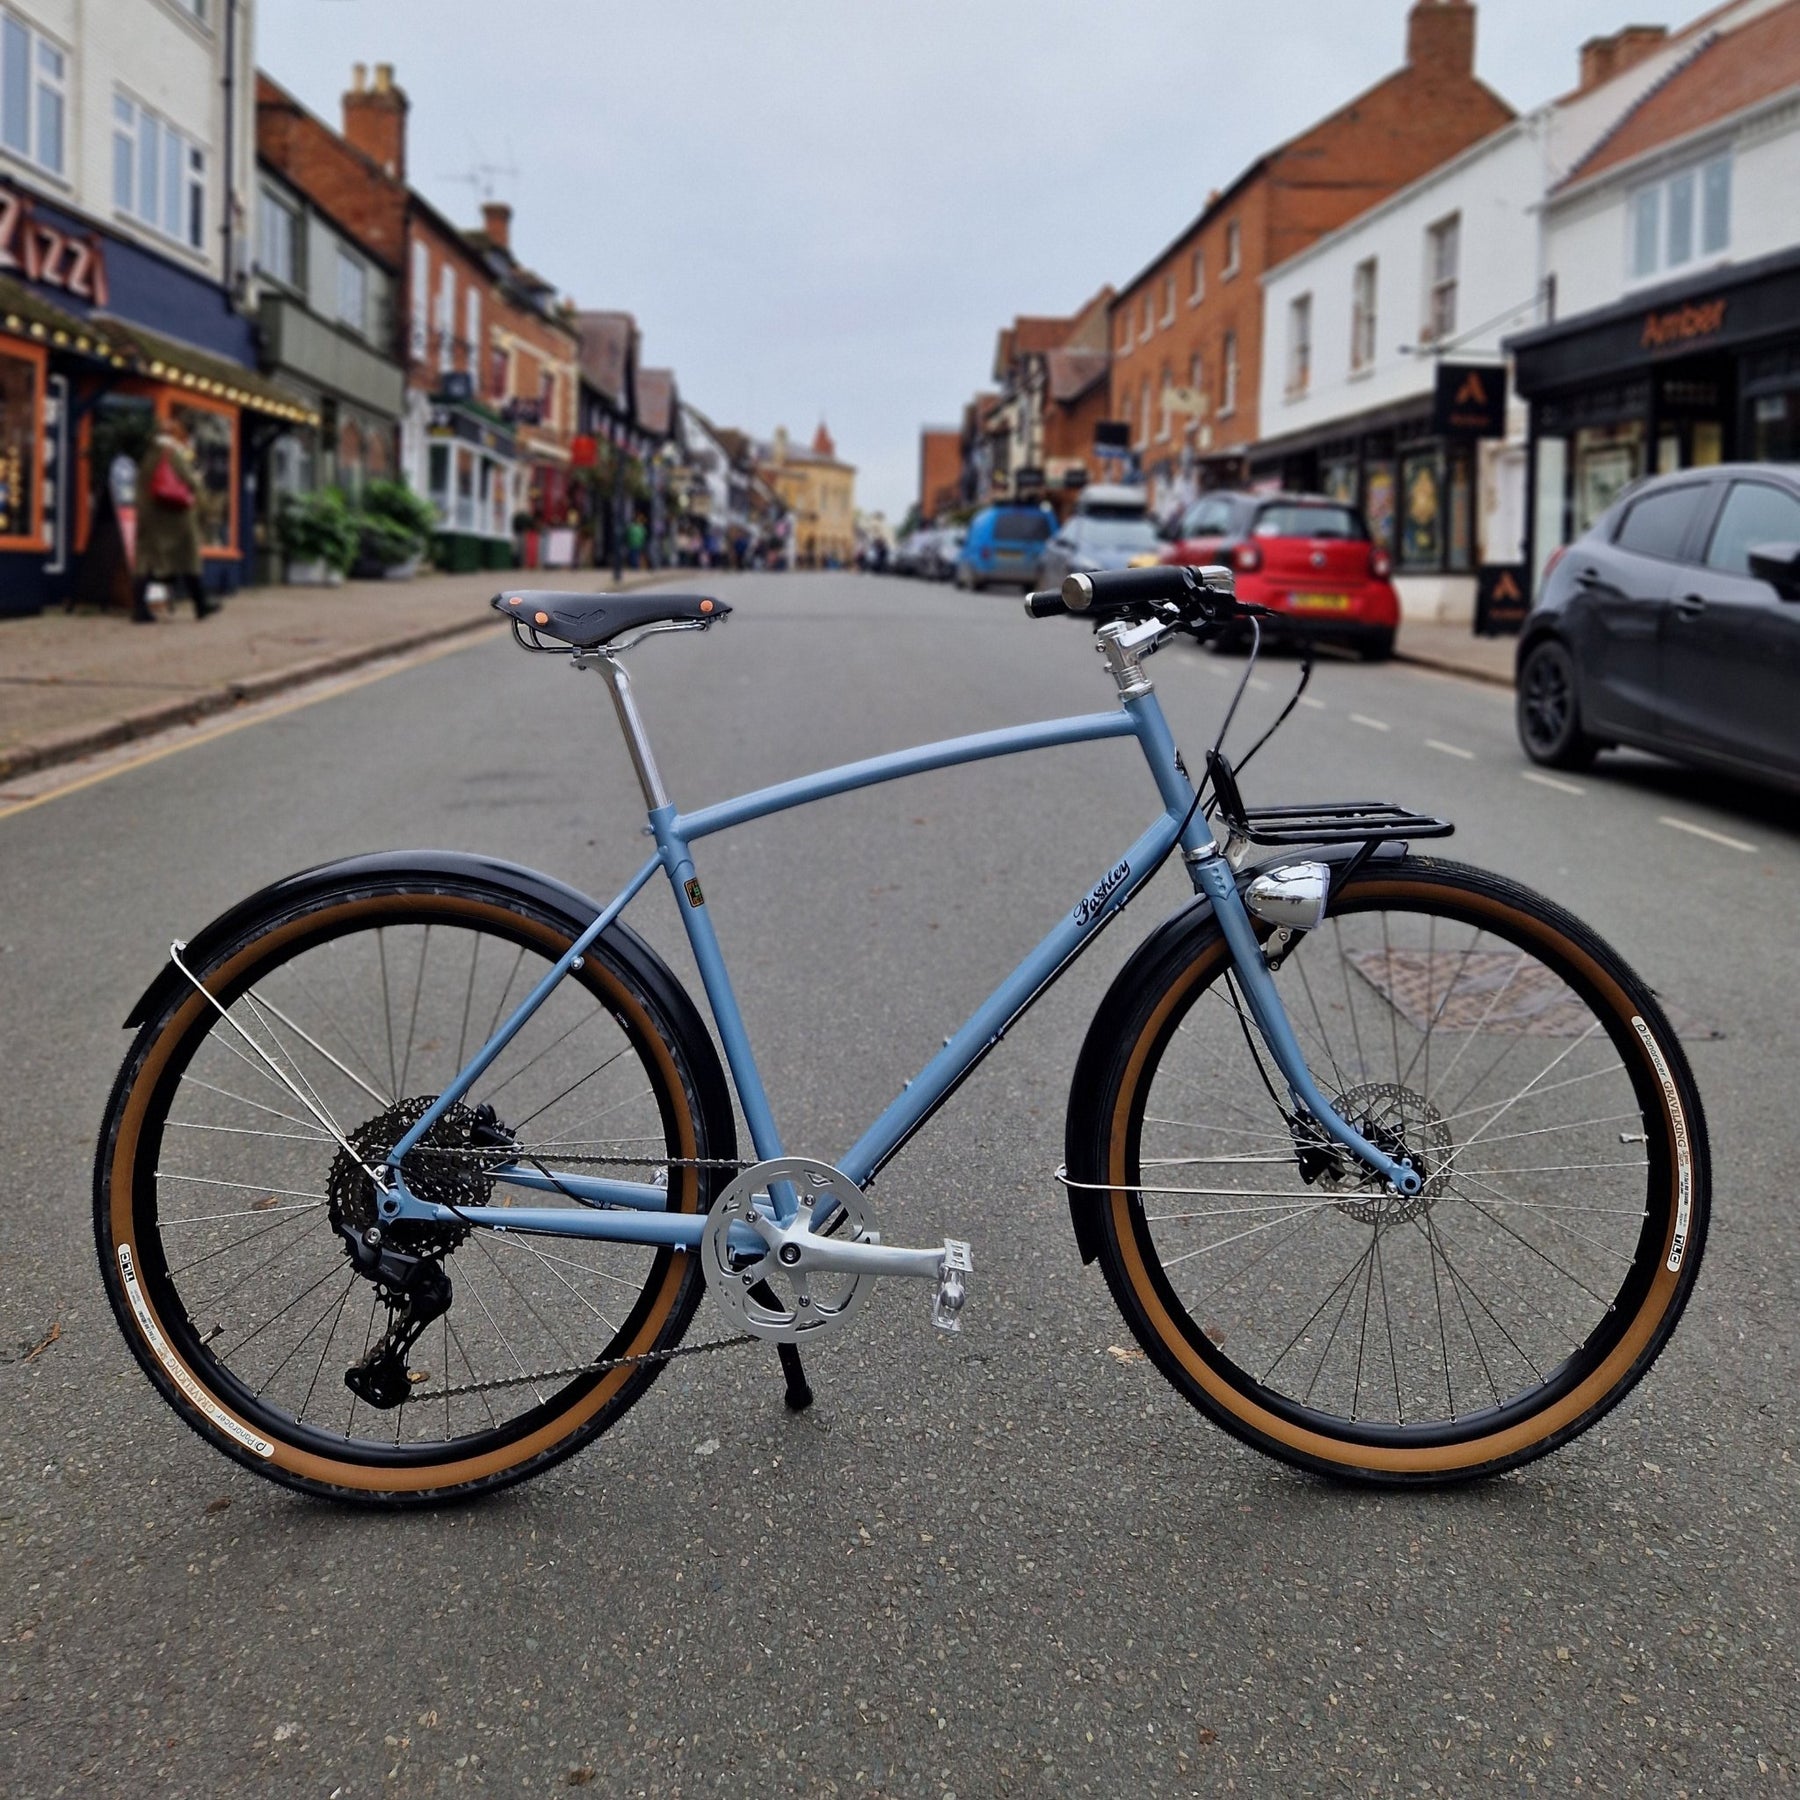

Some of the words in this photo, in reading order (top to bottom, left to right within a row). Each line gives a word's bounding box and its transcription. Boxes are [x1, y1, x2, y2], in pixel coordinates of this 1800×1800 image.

[1073, 859, 1131, 927] Pashley
[1642, 1033, 1667, 1078] Panaracer
[1663, 1080, 1687, 1148] GRAVELKING
[120, 1251, 136, 1283] TLC
[1670, 1233, 1685, 1264] TLC
[166, 1358, 216, 1414] GRAVELKING
[215, 1413, 256, 1447] Panaracer
